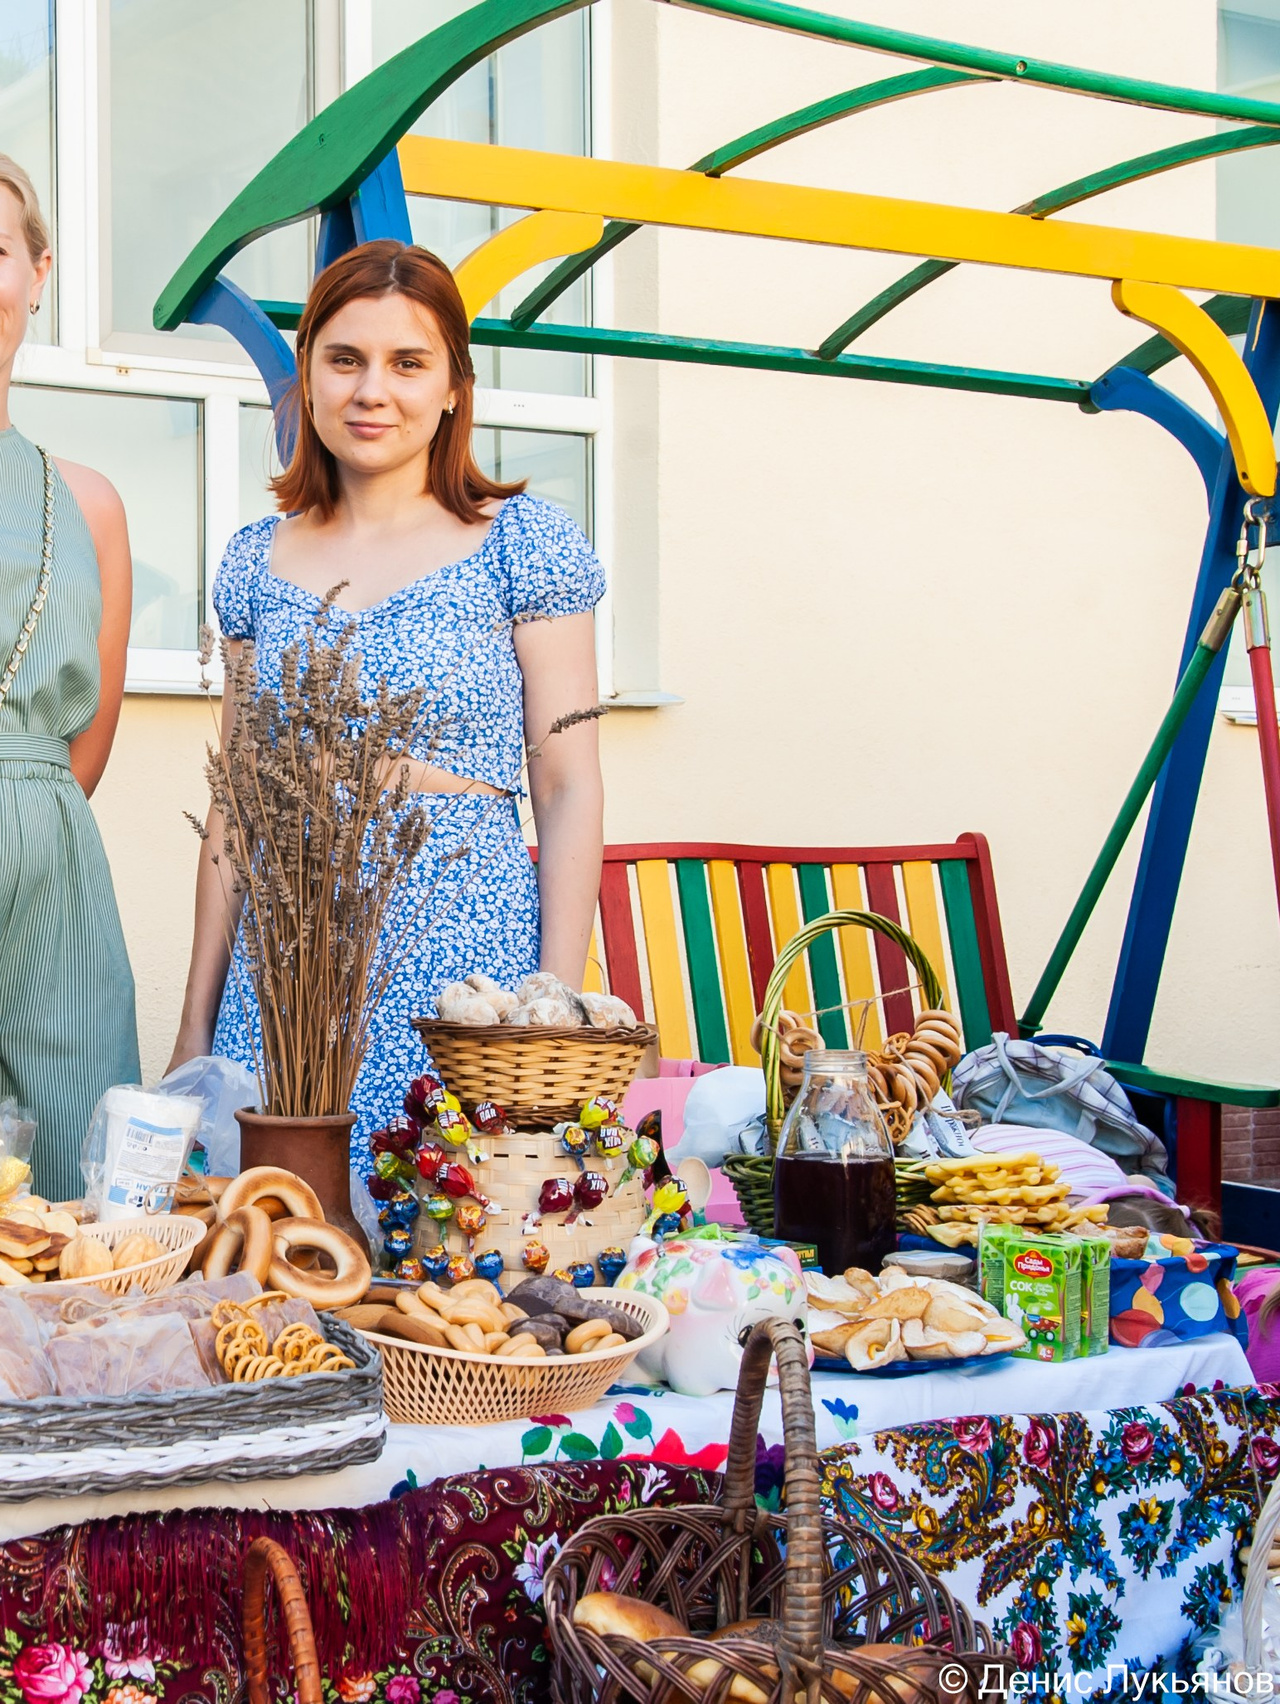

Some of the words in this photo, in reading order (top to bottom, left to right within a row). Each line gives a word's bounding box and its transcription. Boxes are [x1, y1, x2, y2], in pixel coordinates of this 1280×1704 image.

[479, 1108, 497, 1123] BAR
[604, 1137, 622, 1148] MIX
[1010, 1280, 1033, 1292] СОК
